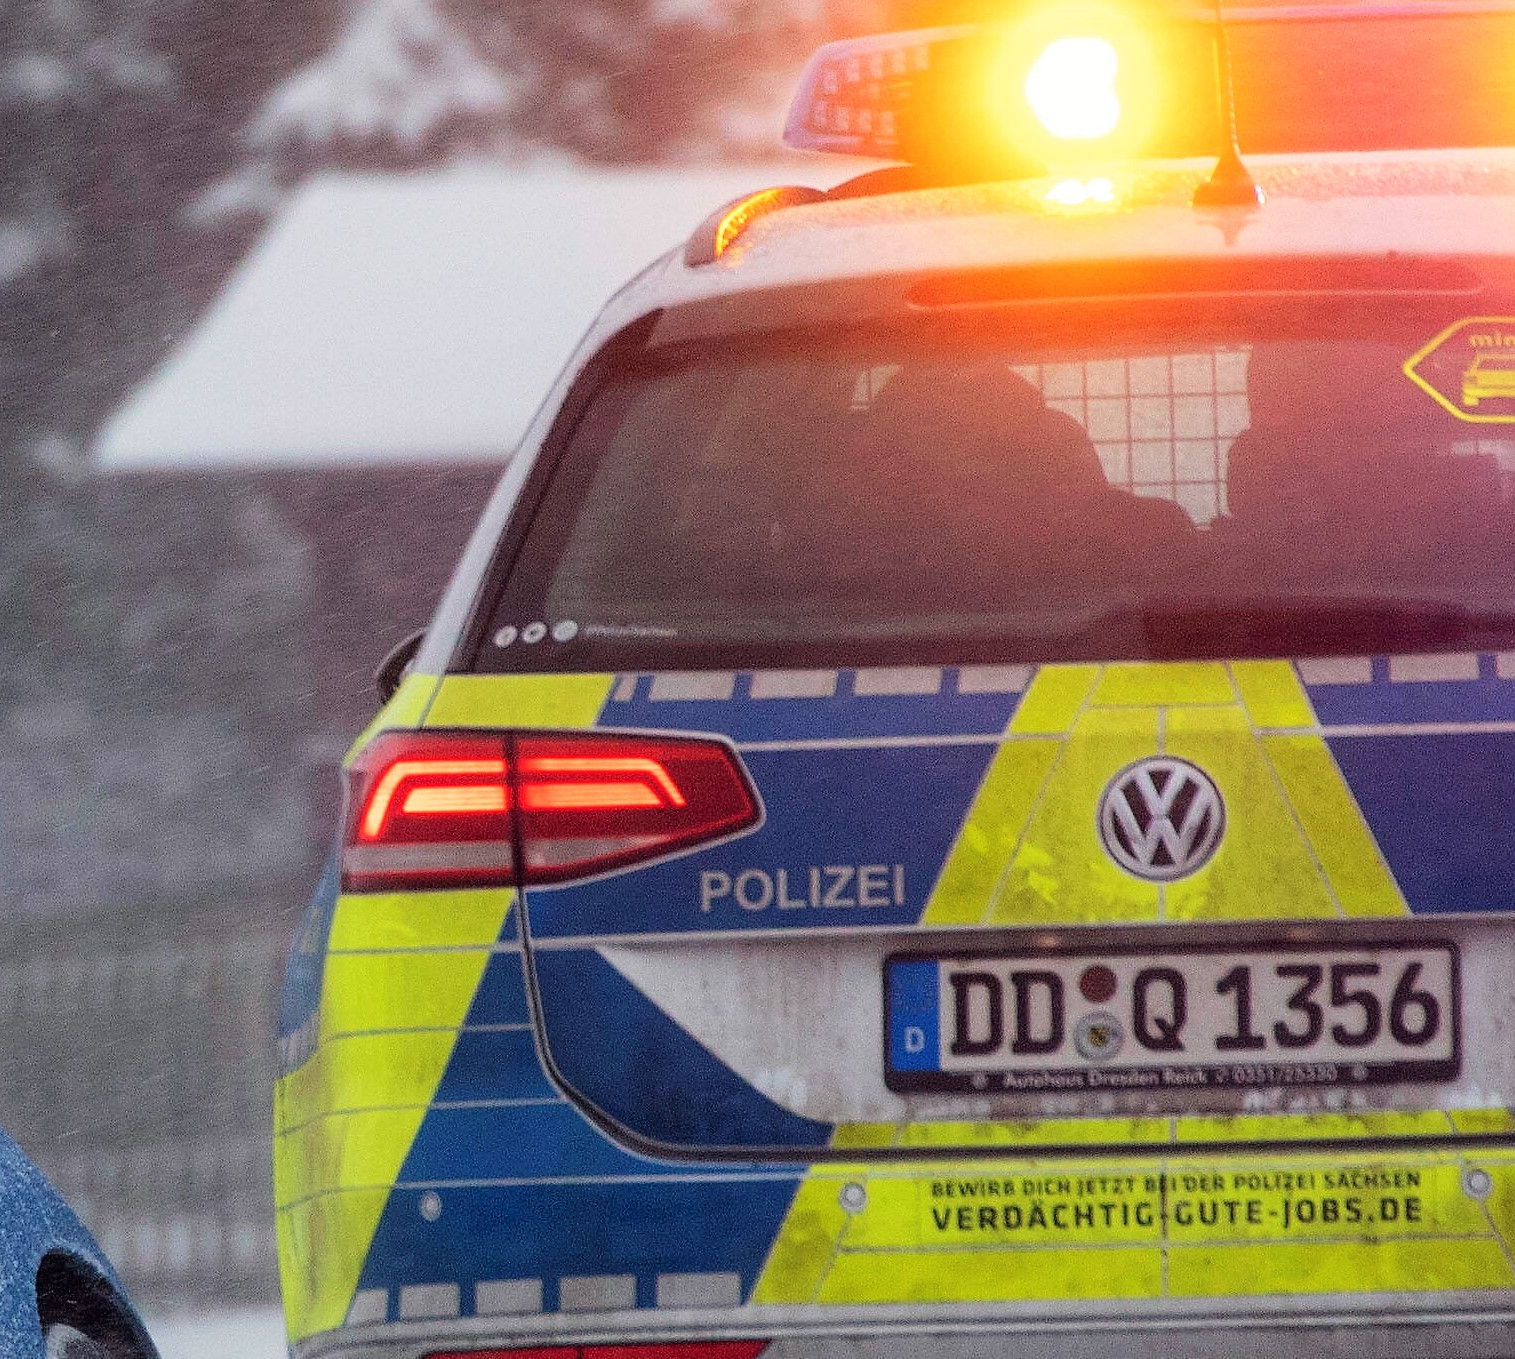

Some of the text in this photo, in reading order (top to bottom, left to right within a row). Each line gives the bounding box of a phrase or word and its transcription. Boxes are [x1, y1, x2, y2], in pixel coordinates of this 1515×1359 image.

[700, 864, 905, 912] POLIZEI
[950, 962, 1440, 1055] DD Q 1356
[904, 1026, 925, 1053] D
[1003, 1071, 1084, 1088] Autohaus
[1088, 1069, 1159, 1086] Dresden
[931, 1180, 1015, 1197] BEWIRB
[1023, 1179, 1070, 1195] DICH
[1077, 1177, 1133, 1197] JETZT
[1183, 1175, 1225, 1192] DER
[1233, 1173, 1315, 1191] POLIZEI
[1323, 1171, 1421, 1190] SACHSEN
[932, 1197, 1422, 1231] VERDÄCHTIG-GUTE-JOBS.DE
